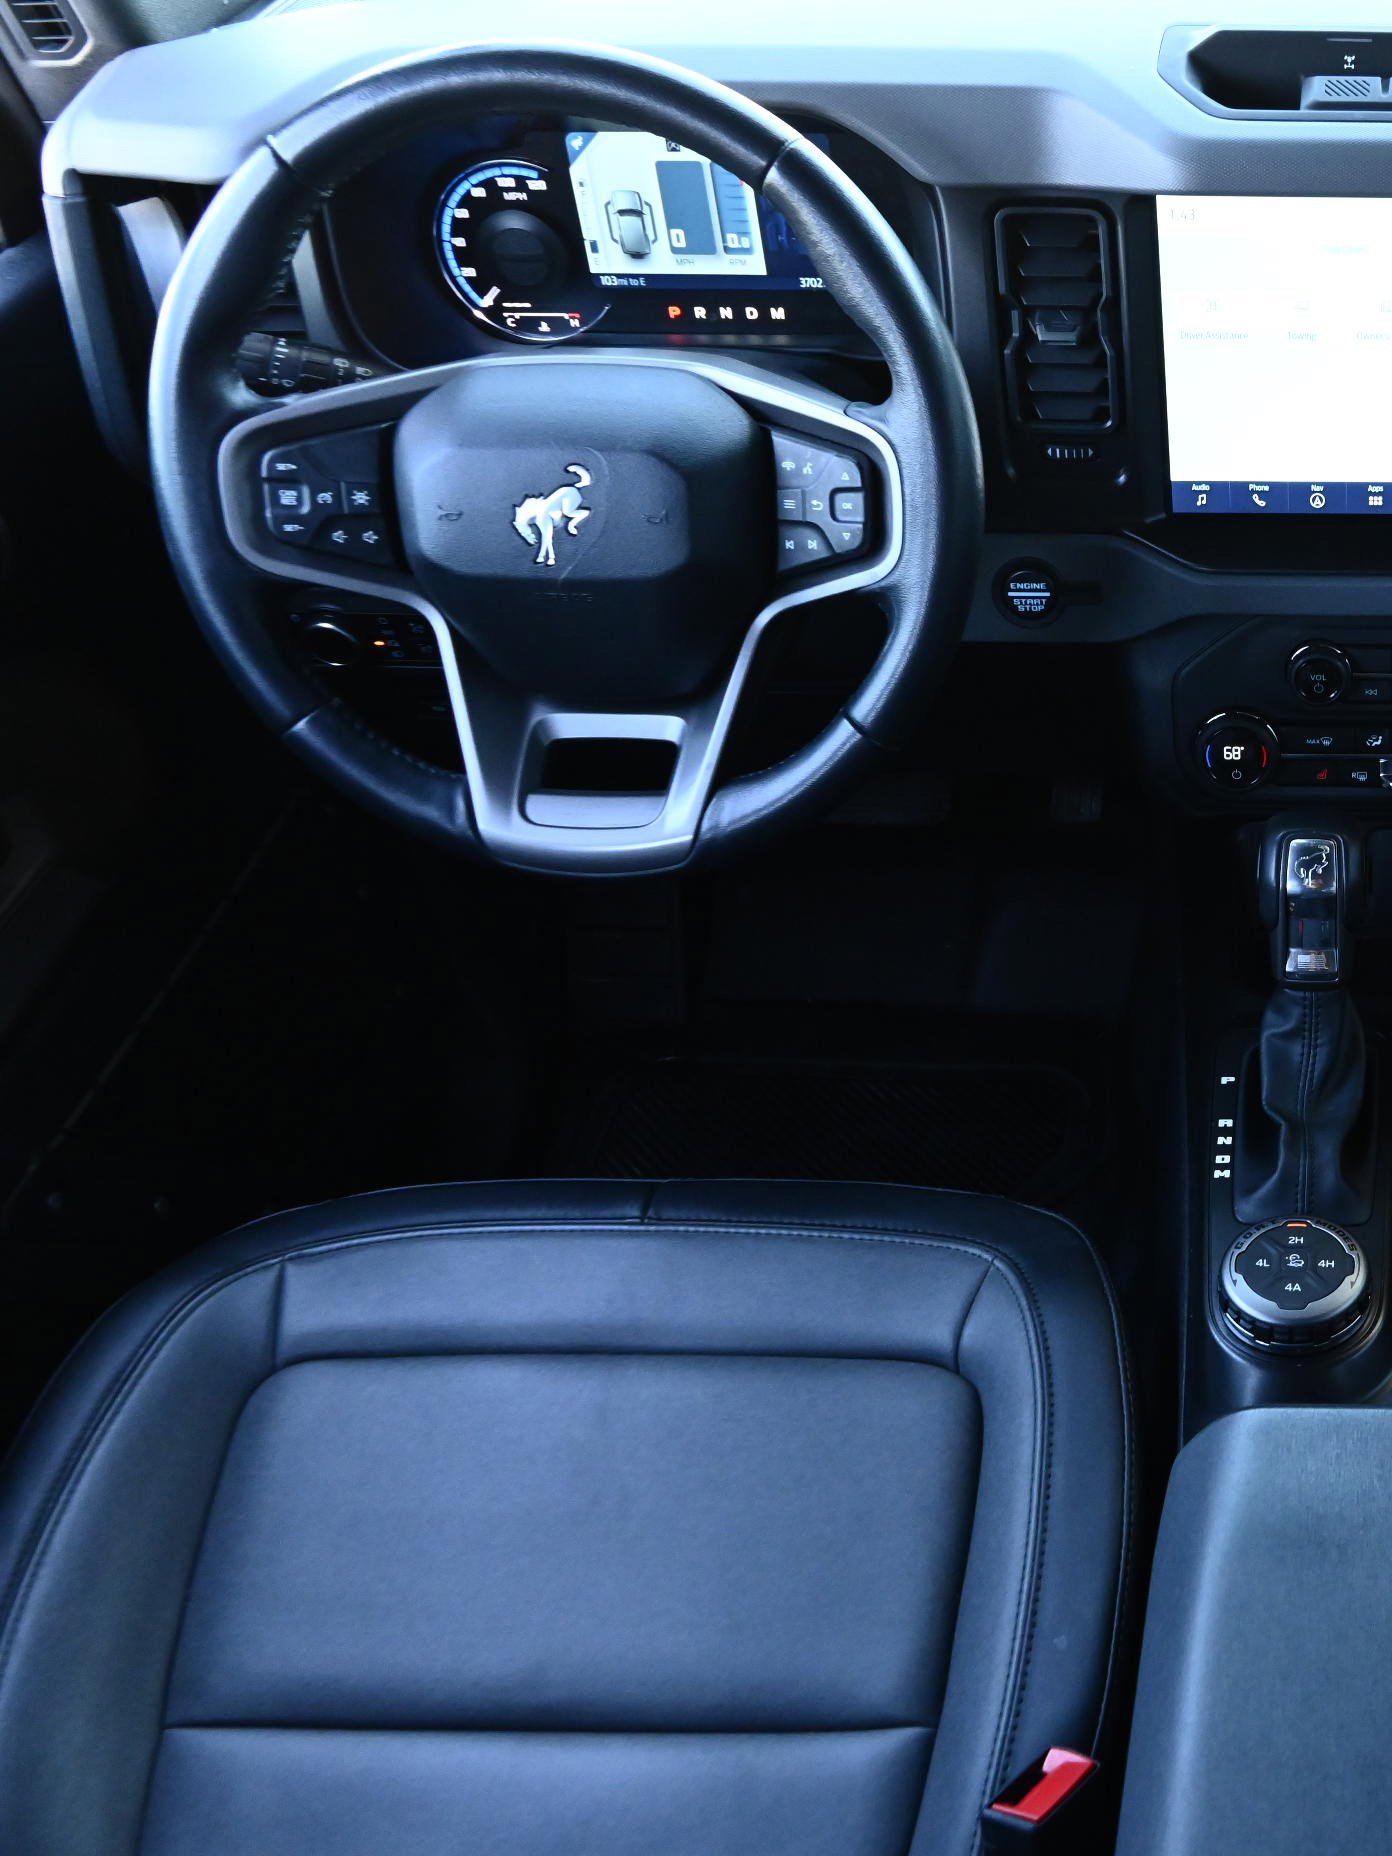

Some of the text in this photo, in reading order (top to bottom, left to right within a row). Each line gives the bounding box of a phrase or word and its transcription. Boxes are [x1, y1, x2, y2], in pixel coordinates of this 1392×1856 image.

[503, 192, 528, 201] MPH
[669, 228, 687, 248] 0
[629, 275, 638, 286] to
[640, 276, 647, 286] E
[668, 306, 786, 320] P R N D M
[505, 317, 517, 327] C
[1191, 483, 1211, 491] Audio
[1248, 483, 1270, 492] Phone
[1310, 484, 1324, 492] Nav
[1367, 484, 1384, 493] Apps
[841, 502, 854, 510] OK
[1010, 582, 1048, 590] ENGINE
[1017, 604, 1045, 612] STOP
[1309, 673, 1328, 681] VOL
[1220, 1076, 1236, 1085] P
[1216, 1136, 1233, 1145] N
[1215, 1154, 1231, 1164] D
[1213, 1169, 1231, 1178] M
[1315, 1219, 1358, 1252] MODES
[1288, 1236, 1304, 1245] 2H
[1255, 1258, 1271, 1268] 4L
[1317, 1259, 1335, 1269] 4H
[1284, 1282, 1302, 1292] 4A
